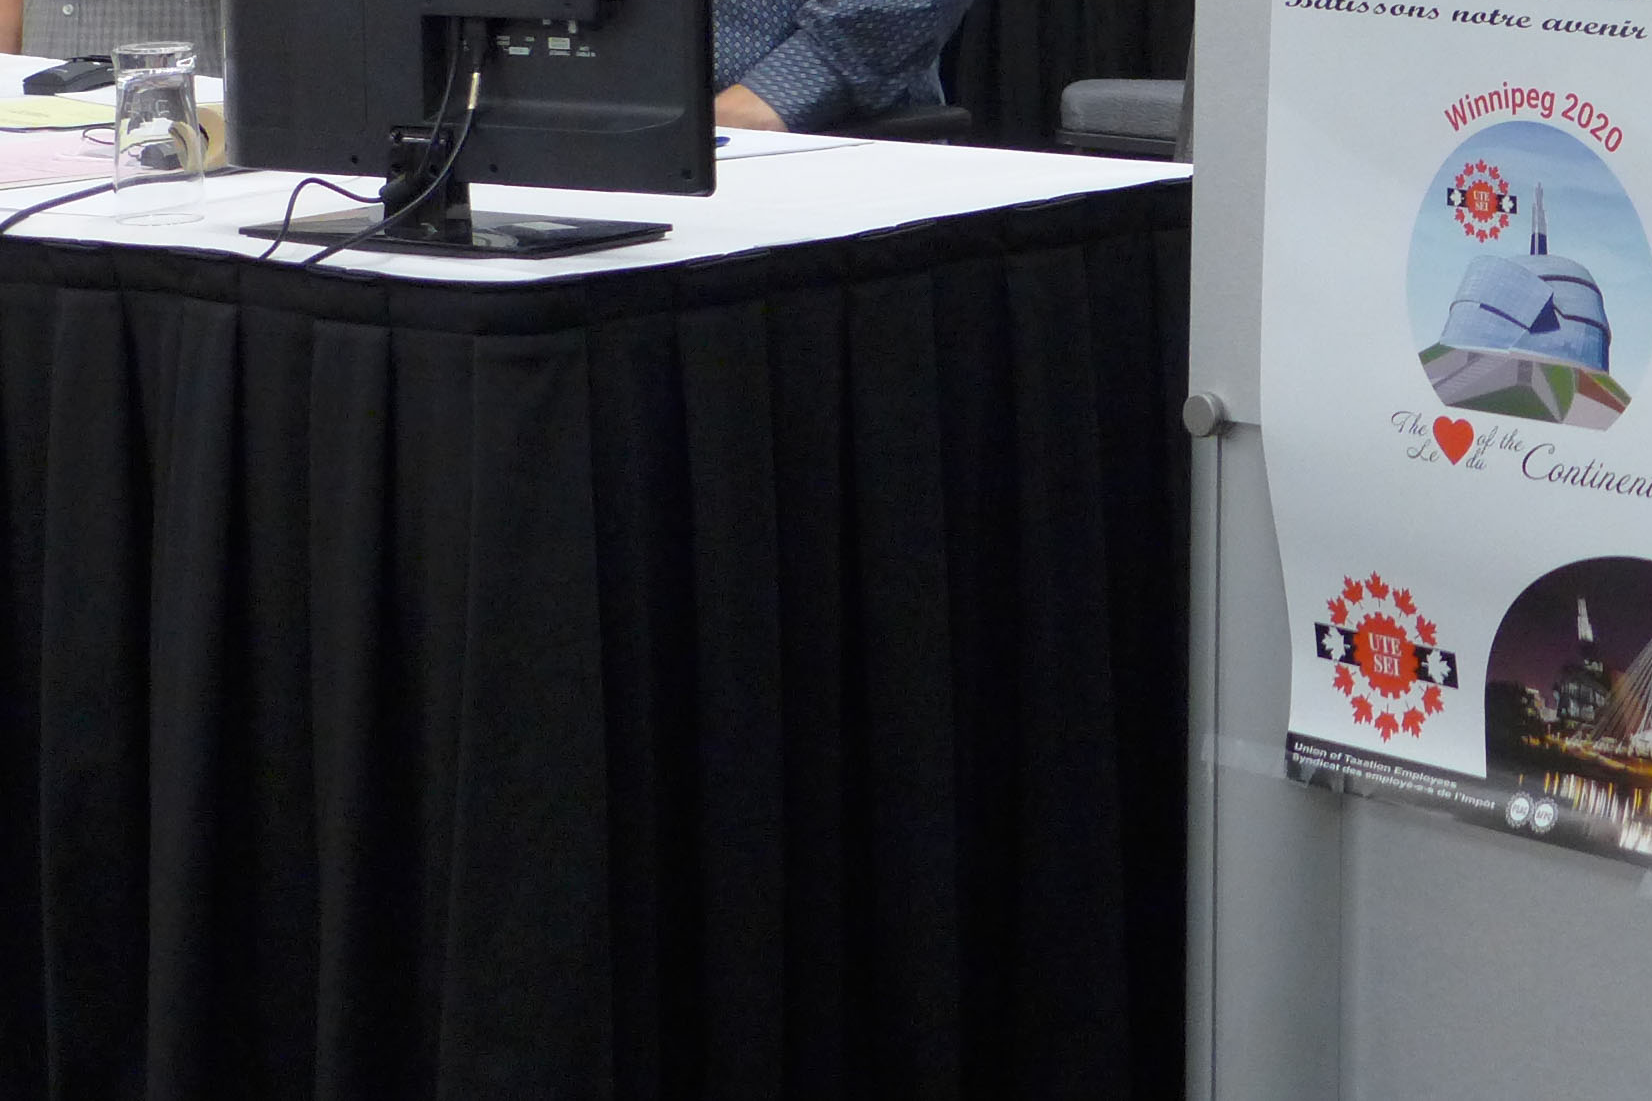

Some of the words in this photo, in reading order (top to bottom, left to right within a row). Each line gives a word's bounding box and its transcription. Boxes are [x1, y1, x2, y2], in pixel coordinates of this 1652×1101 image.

[1452, 9, 1533, 30] notre
[1541, 18, 1649, 40] avenir
[1444, 81, 1556, 132] Winnipeg
[1561, 93, 1623, 153] 2020
[1391, 411, 1428, 436] The
[1476, 426, 1499, 447] of
[1500, 429, 1524, 452] the
[1368, 632, 1402, 657] UTE
[1373, 654, 1400, 677] SEI
[1294, 742, 1327, 760] Union
[1329, 752, 1343, 762] of
[1345, 754, 1391, 773] Taxation
[1394, 767, 1458, 789] Employees
